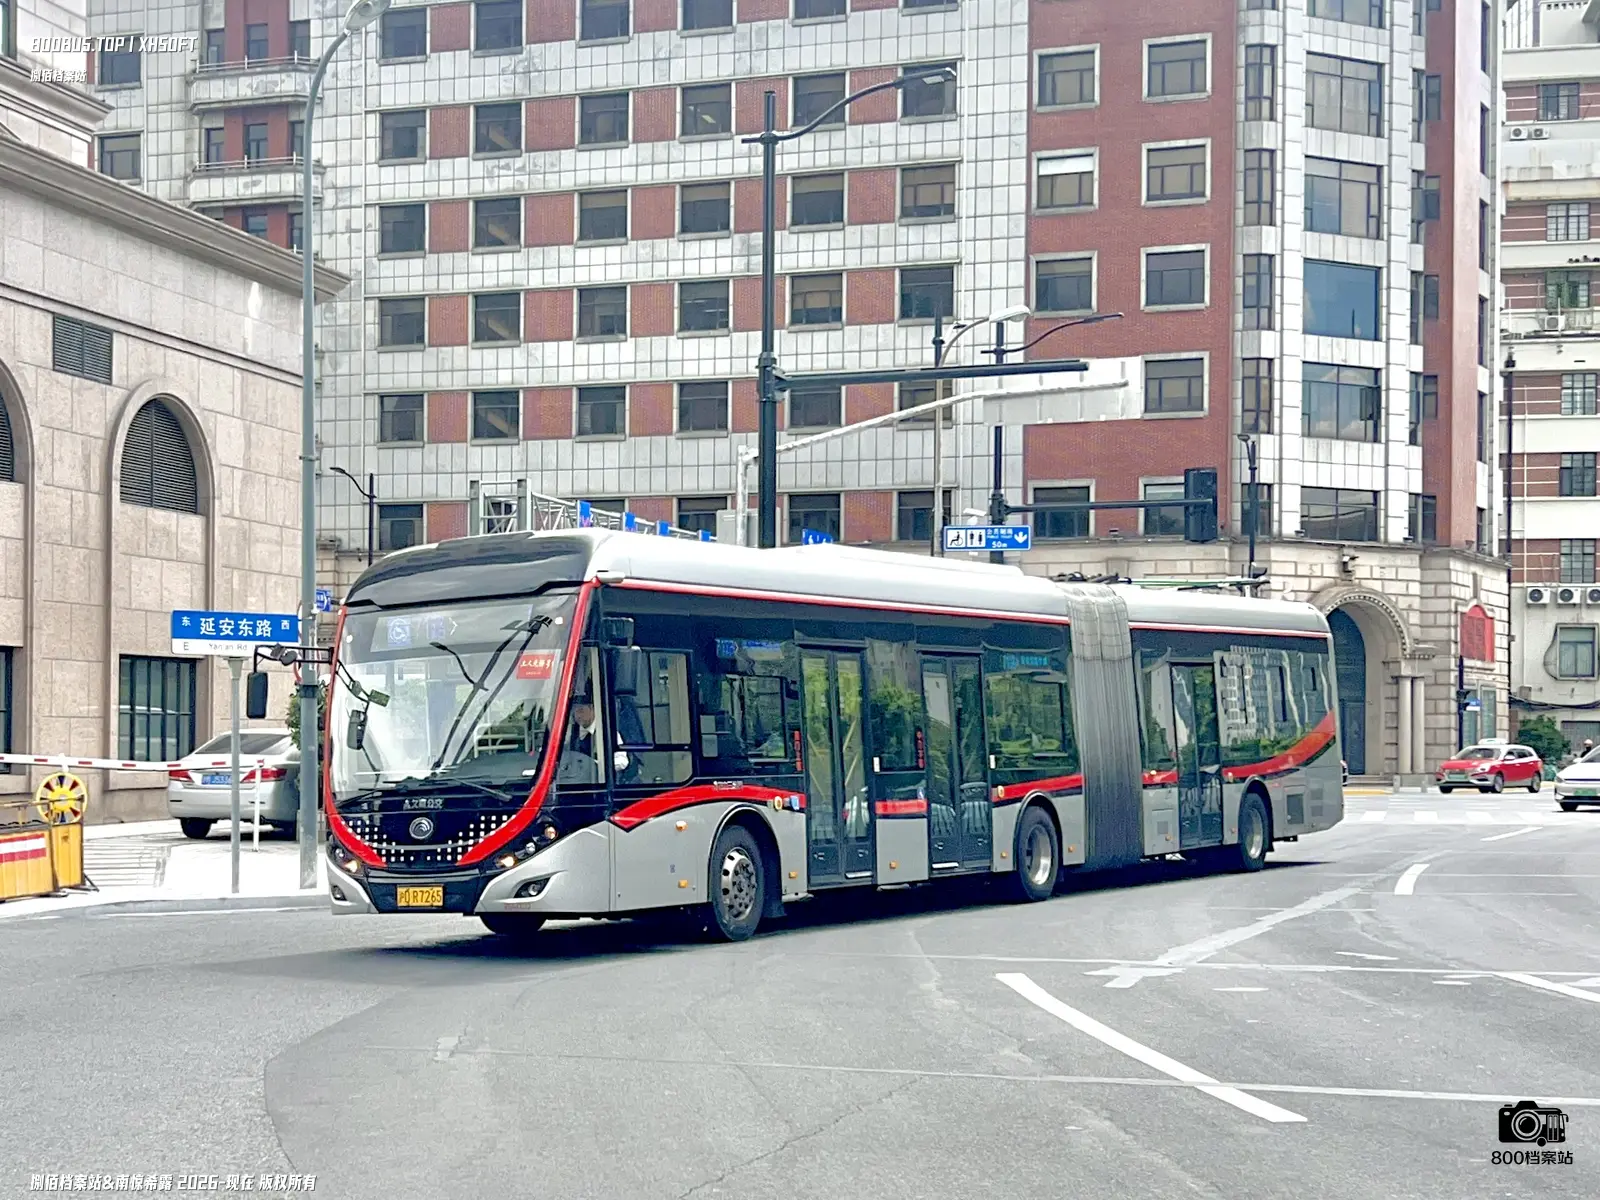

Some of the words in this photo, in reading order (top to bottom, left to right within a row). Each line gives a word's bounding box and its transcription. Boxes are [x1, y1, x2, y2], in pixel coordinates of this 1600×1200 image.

[181, 616, 191, 627] 东
[200, 617, 272, 638] 延安东路
[281, 619, 291, 630] 西
[183, 641, 190, 651] E
